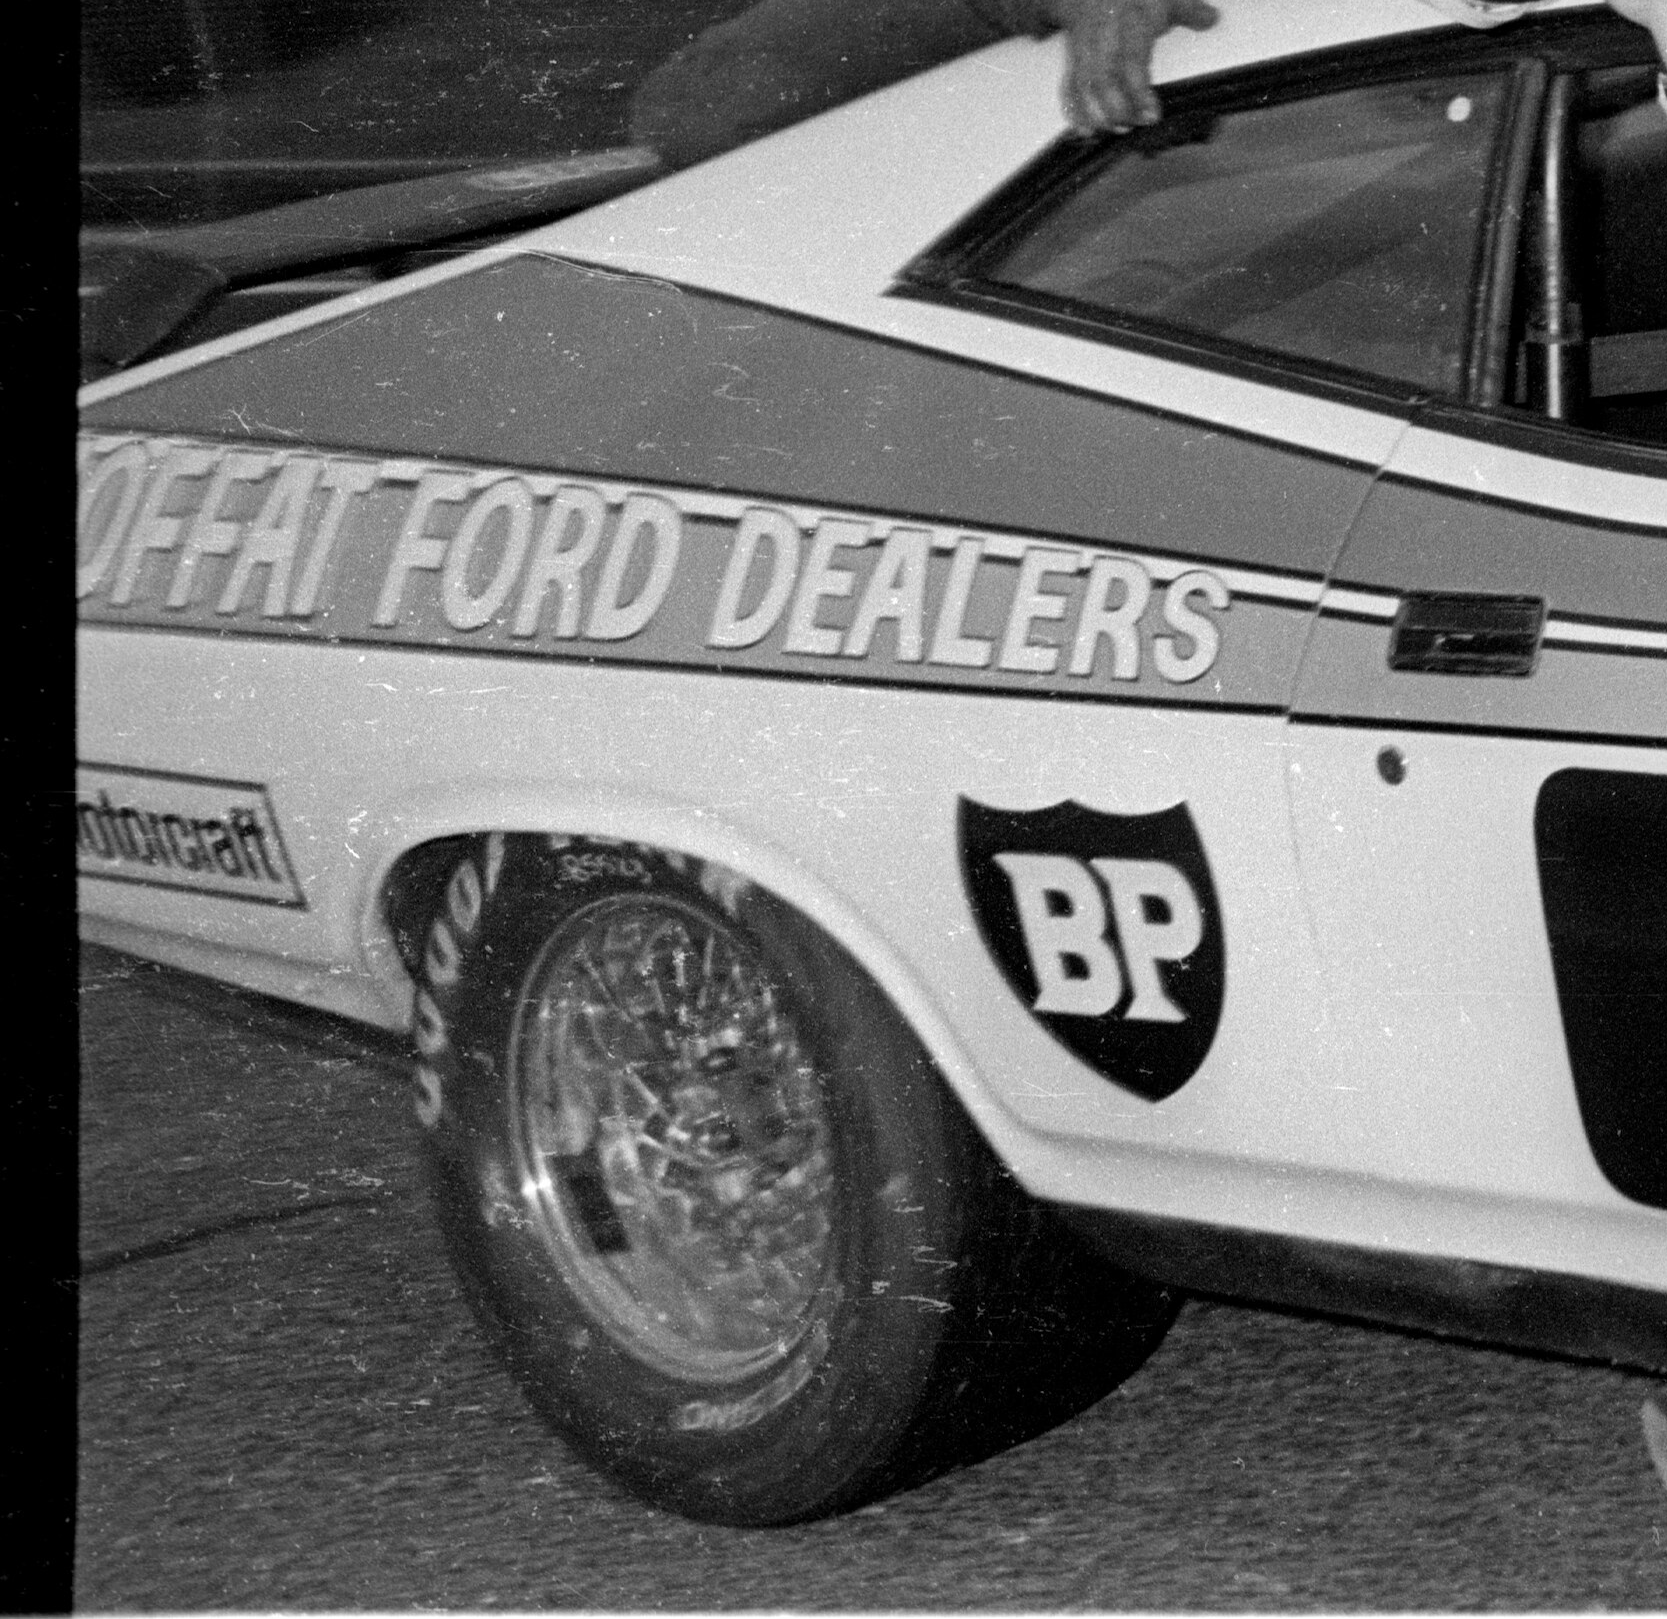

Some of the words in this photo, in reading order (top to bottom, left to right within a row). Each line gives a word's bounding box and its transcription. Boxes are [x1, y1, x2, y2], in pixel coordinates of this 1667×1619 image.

[370, 466, 682, 641] FORD
[705, 506, 1230, 682] DEALERS
[991, 852, 1203, 1020] BP
